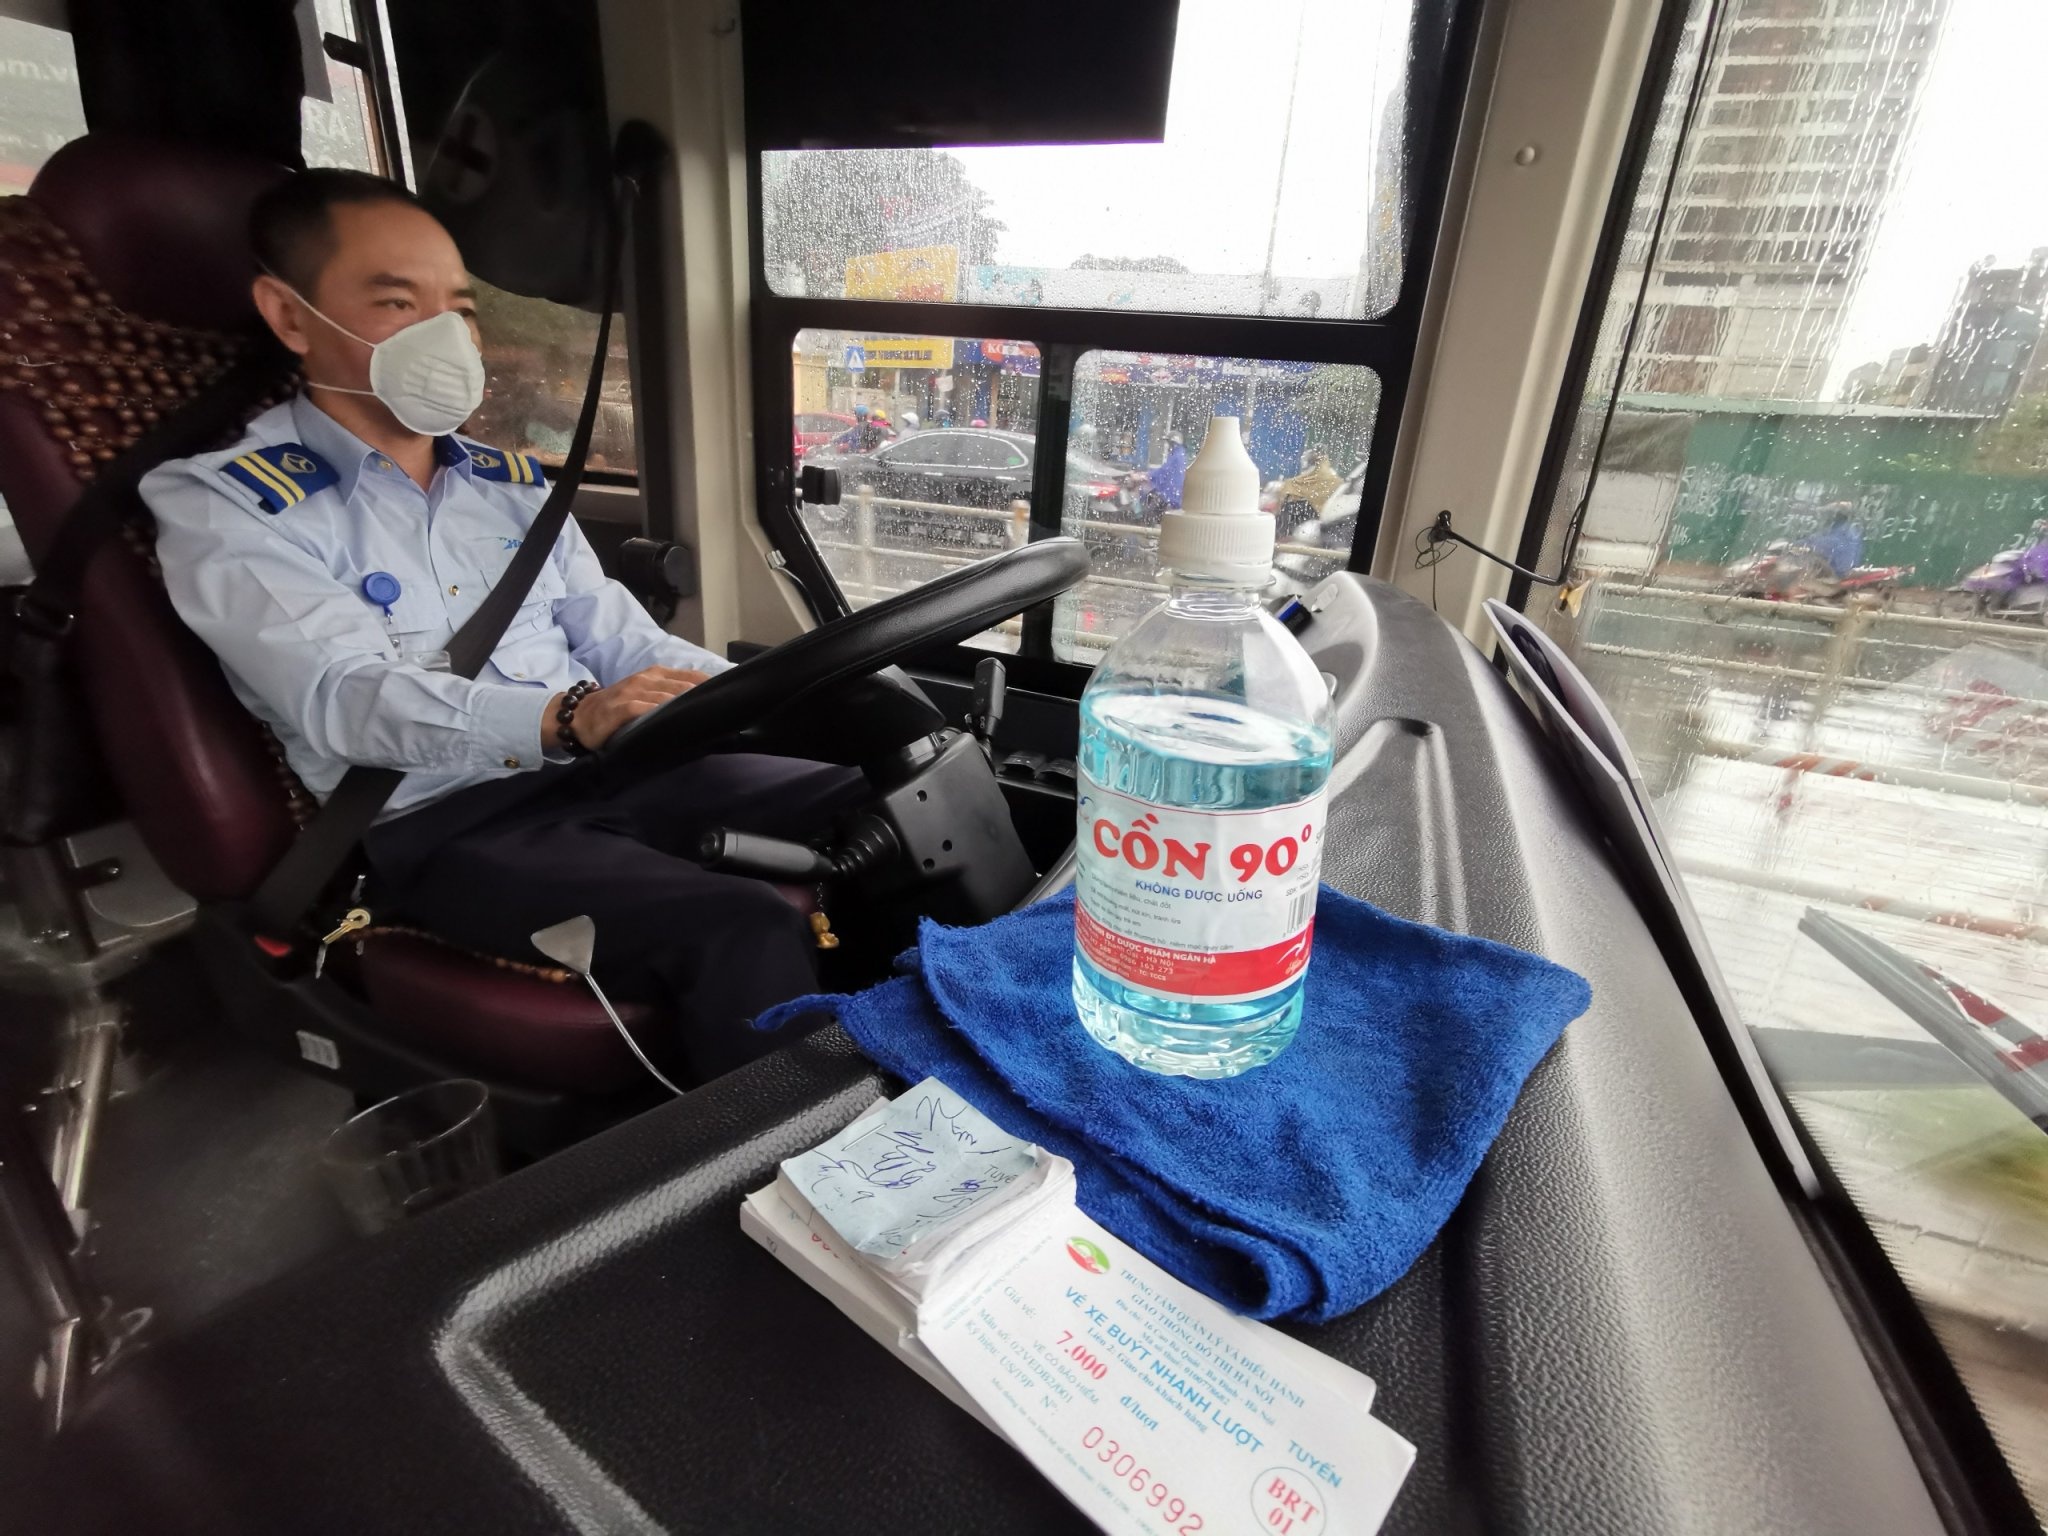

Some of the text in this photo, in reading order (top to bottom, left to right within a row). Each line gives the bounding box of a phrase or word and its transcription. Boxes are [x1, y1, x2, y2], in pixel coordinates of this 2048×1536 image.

[1093, 813, 1212, 881] CỒN
[1135, 879, 1180, 898] KHÔNG
[1184, 888, 1223, 904] ĐƯỢC
[1227, 888, 1263, 904] UỐNG
[1146, 955, 1158, 964] Hà
[1159, 957, 1174, 967] Nội
[1158, 965, 1174, 976] 273
[1172, 951, 1201, 963] NGÂN
[1202, 954, 1217, 965] HÀ
[1003, 1286, 1024, 1305] Giá
[1055, 1329, 1108, 1380] 7.000
[1119, 1394, 1160, 1432] đ/lượt
[1120, 1269, 1305, 1408] TRUNG TÂM QUẢN LÝ VÀ ĐIỀU HÀNH
[1131, 1294, 1158, 1316] GIAO
[1159, 1314, 1194, 1345] THÔNG
[1194, 1342, 1213, 1358] ĐÔ
[1234, 1370, 1249, 1388] HÀ
[1254, 1383, 1275, 1406] NỘI
[1065, 1286, 1264, 1454] VÉ XE BUÝT NHANH LƯỢT
[1116, 1352, 1138, 1374] Giao
[1138, 1371, 1155, 1388] cho
[1154, 1383, 1184, 1412] khách
[1082, 1426, 1204, 1536] 0306992
[1287, 1439, 1343, 1489] TUYẾN
[1267, 1476, 1320, 1523] BRT
[1268, 1506, 1295, 1536] 01
